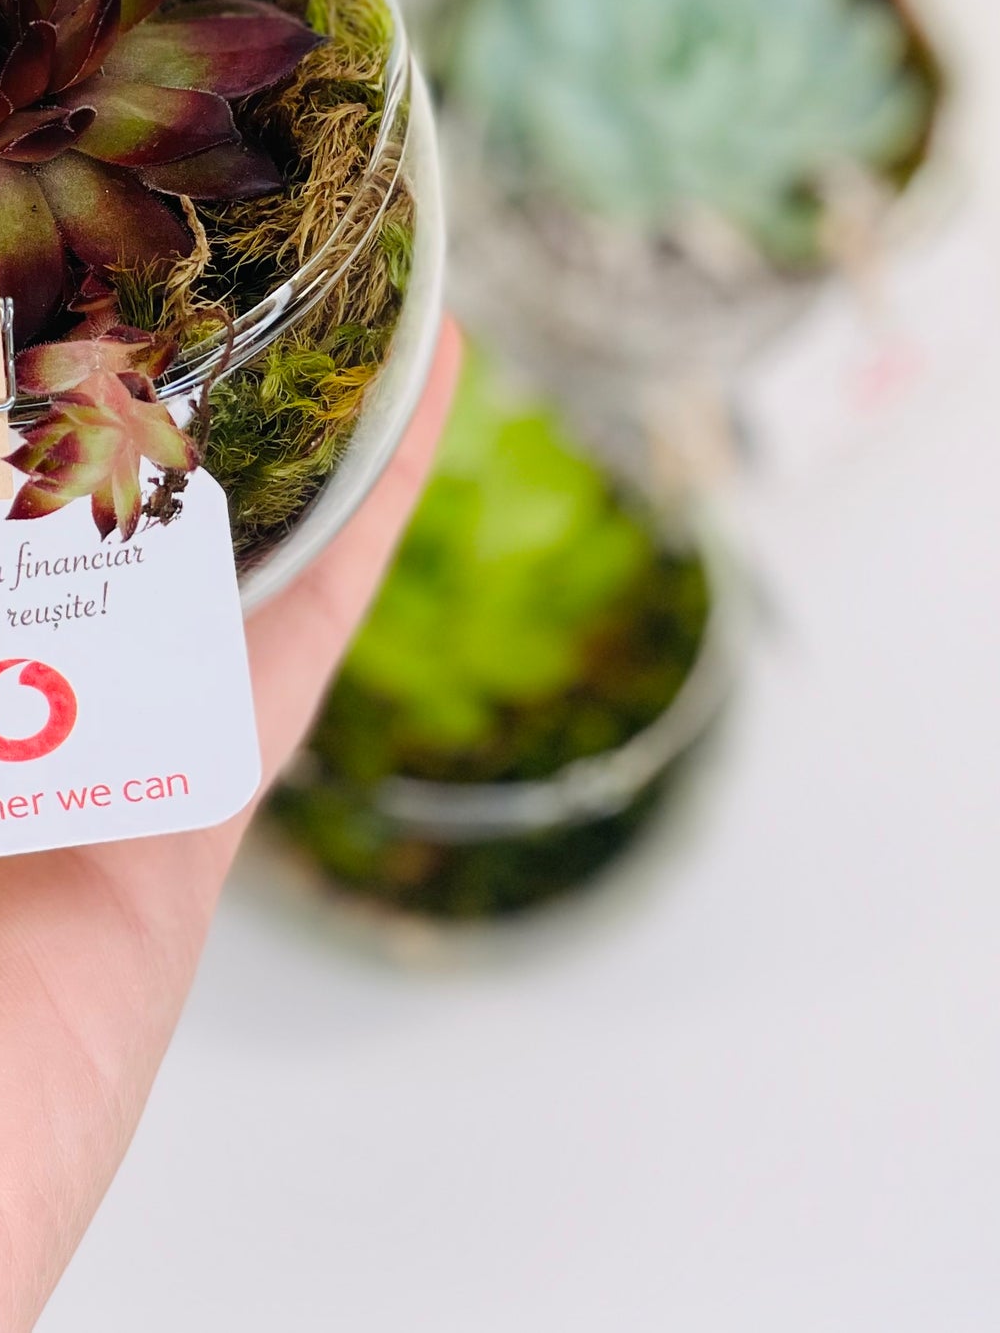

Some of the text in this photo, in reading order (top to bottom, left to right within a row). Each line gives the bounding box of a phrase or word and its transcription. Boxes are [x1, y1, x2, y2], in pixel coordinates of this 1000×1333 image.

[9, 540, 145, 592] financiar
[56, 784, 112, 811] we
[122, 772, 189, 803] can
